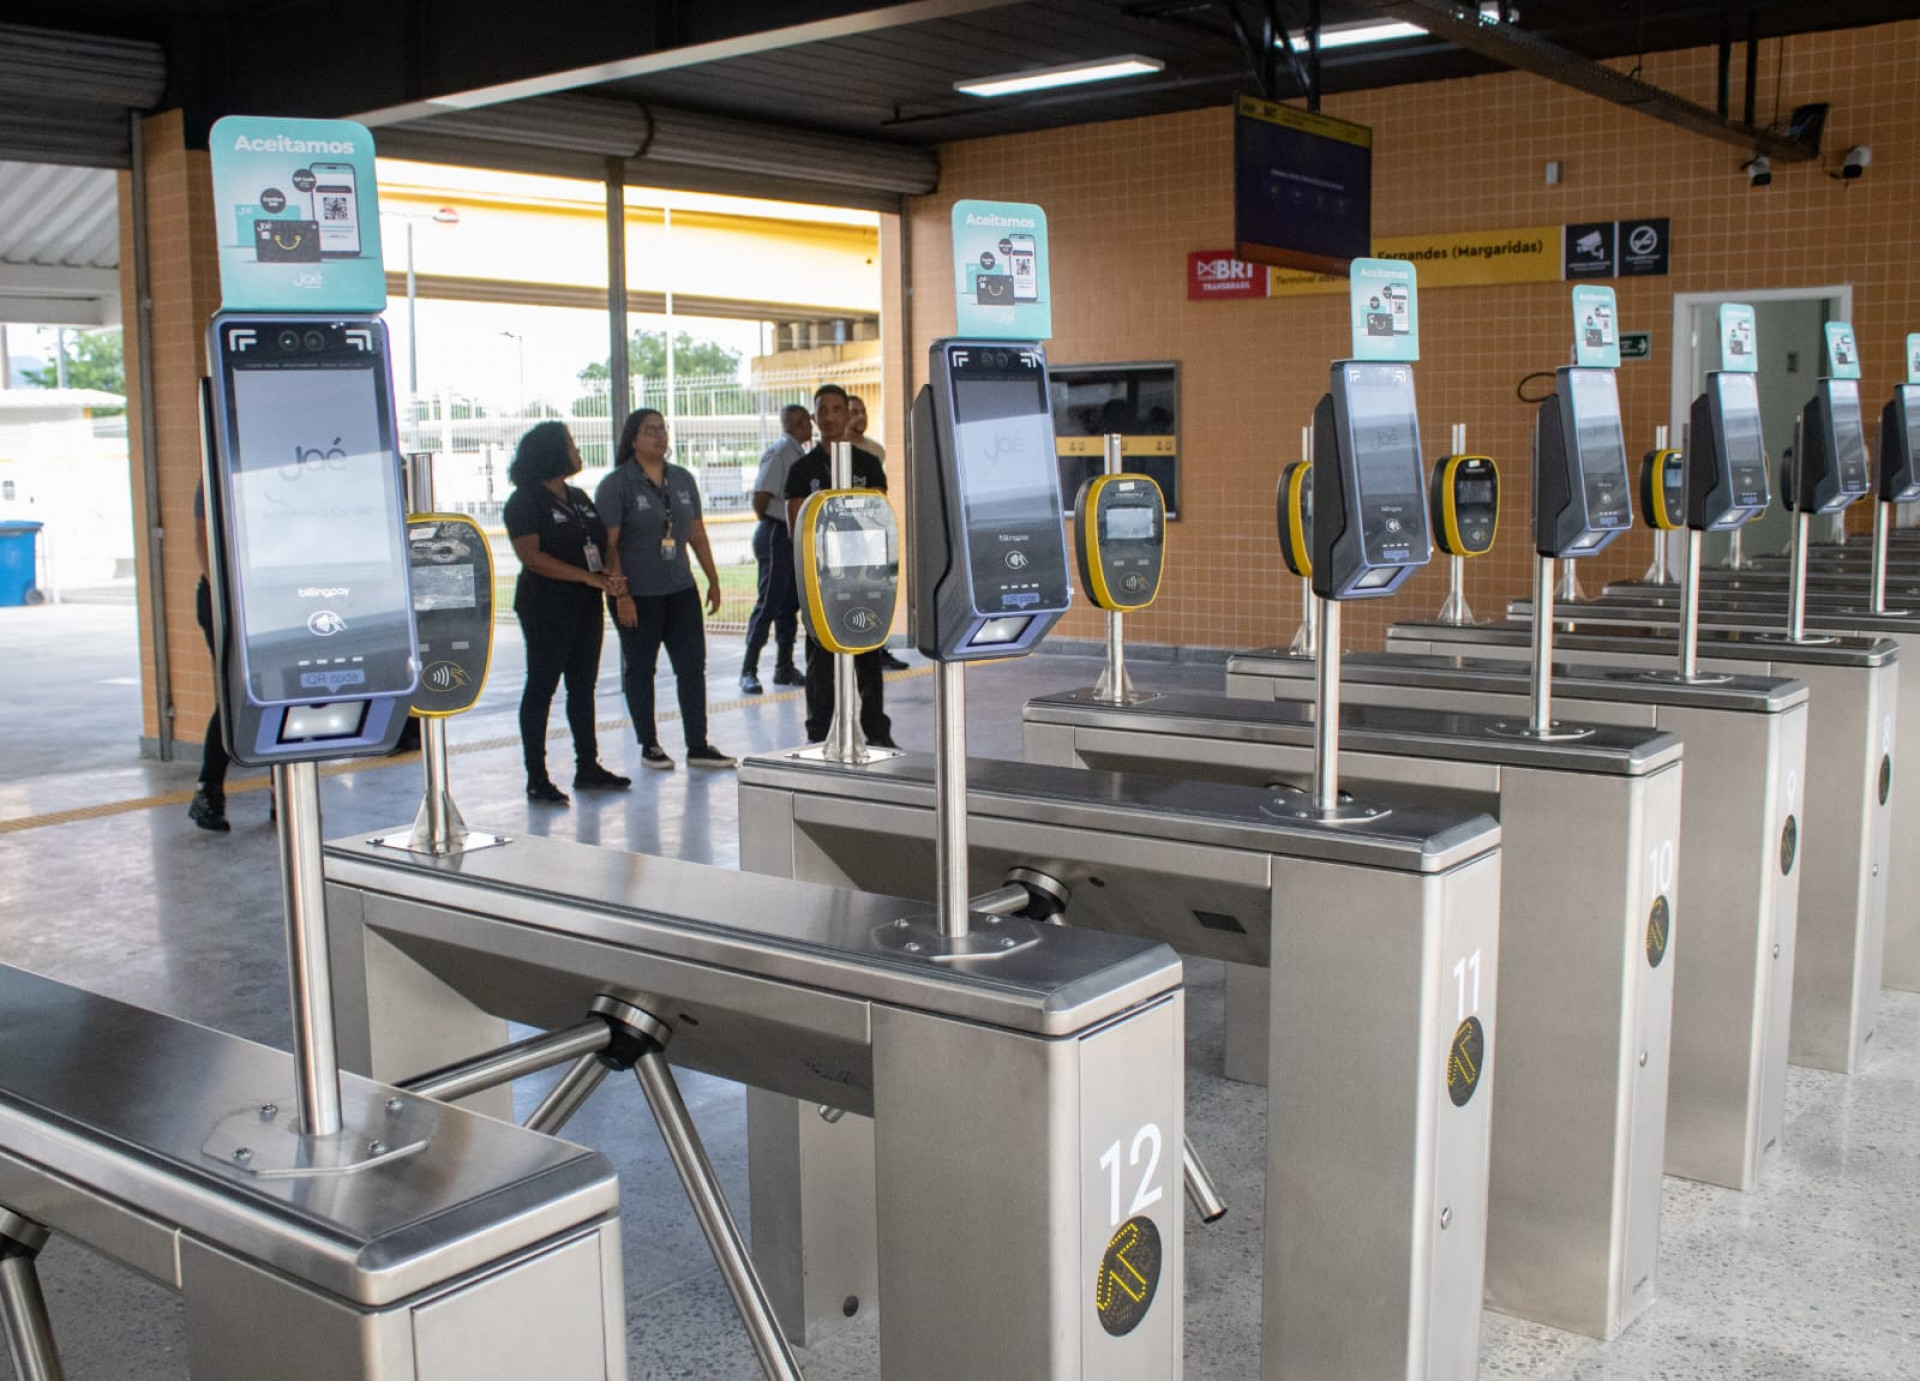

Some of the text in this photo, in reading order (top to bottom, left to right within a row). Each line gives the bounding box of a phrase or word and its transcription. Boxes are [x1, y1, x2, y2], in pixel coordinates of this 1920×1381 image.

[234, 135, 355, 155] Aceitamos
[966, 213, 1036, 229] Aceitamos
[1377, 239, 1544, 261] Fernandes (Margaridas)
[279, 437, 348, 482] Jaé
[298, 586, 350, 599] billingpay
[306, 671, 360, 686] QR code
[1786, 767, 1797, 813] 9
[1649, 839, 1673, 898] 10
[1453, 948, 1481, 1022] 11
[1099, 1121, 1163, 1228] 12
